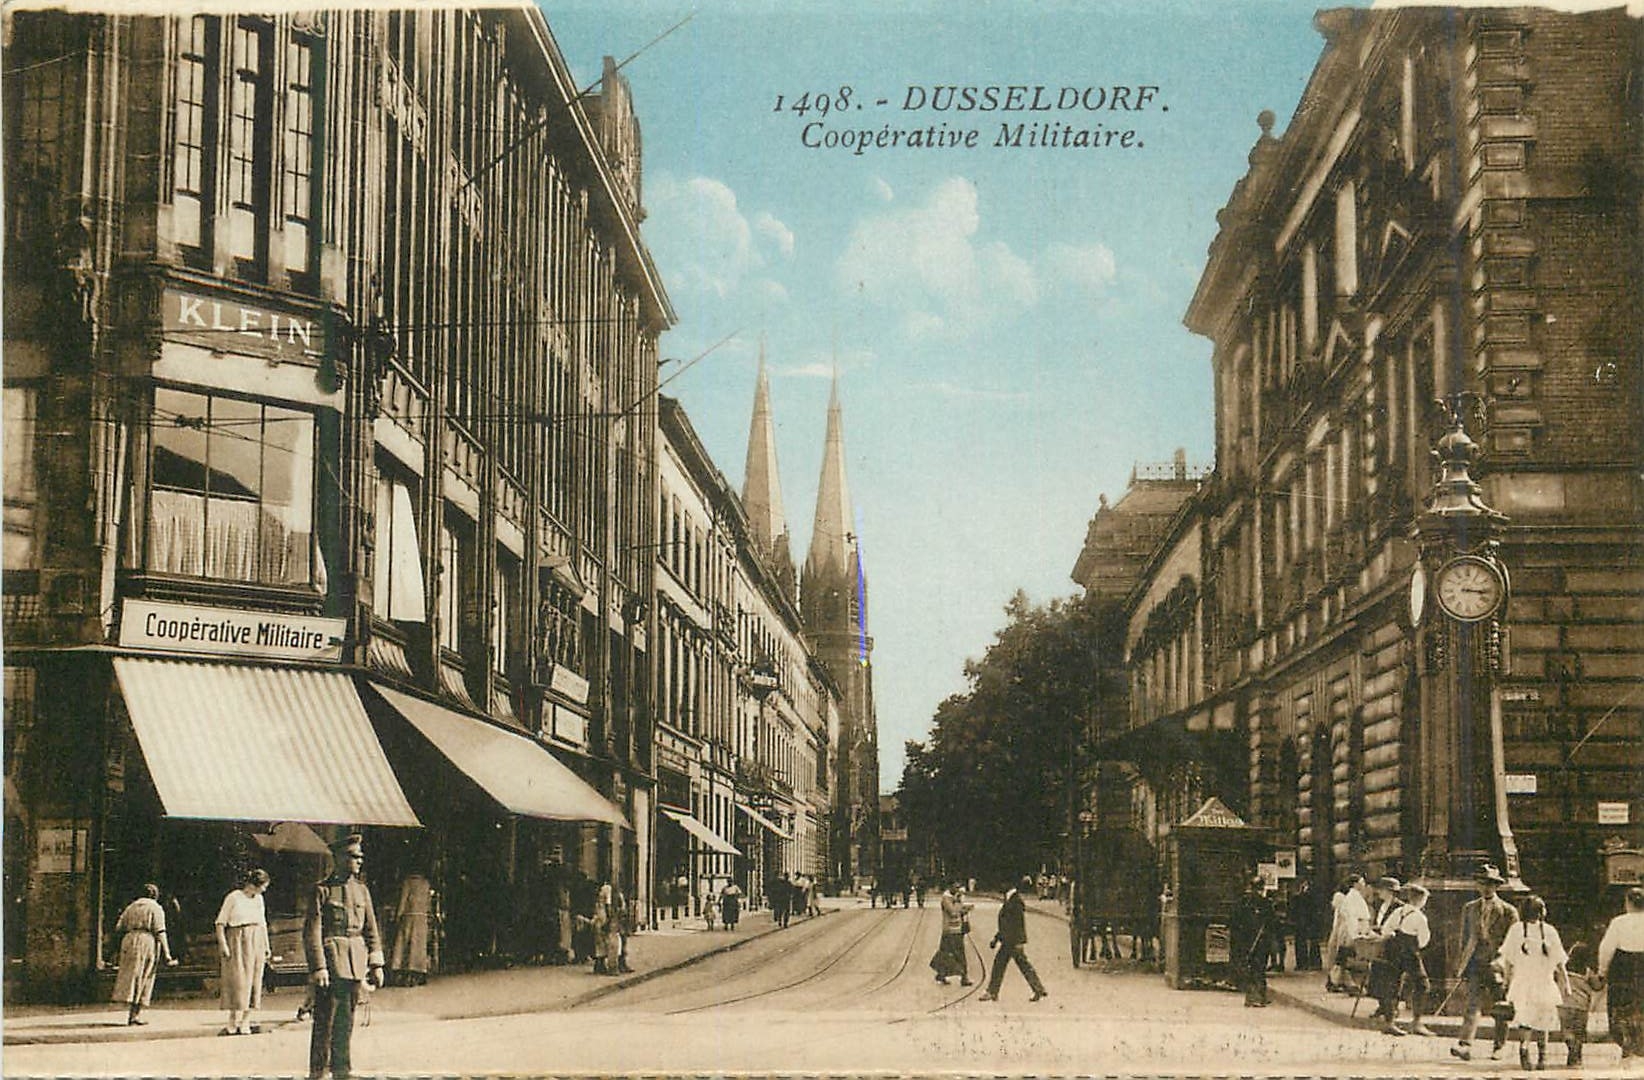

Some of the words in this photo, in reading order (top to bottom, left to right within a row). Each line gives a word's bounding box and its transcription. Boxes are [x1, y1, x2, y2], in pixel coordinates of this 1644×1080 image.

[178, 295, 312, 347] KLEIN
[145, 612, 252, 644] Coopérative
[256, 622, 323, 649] Militaire
